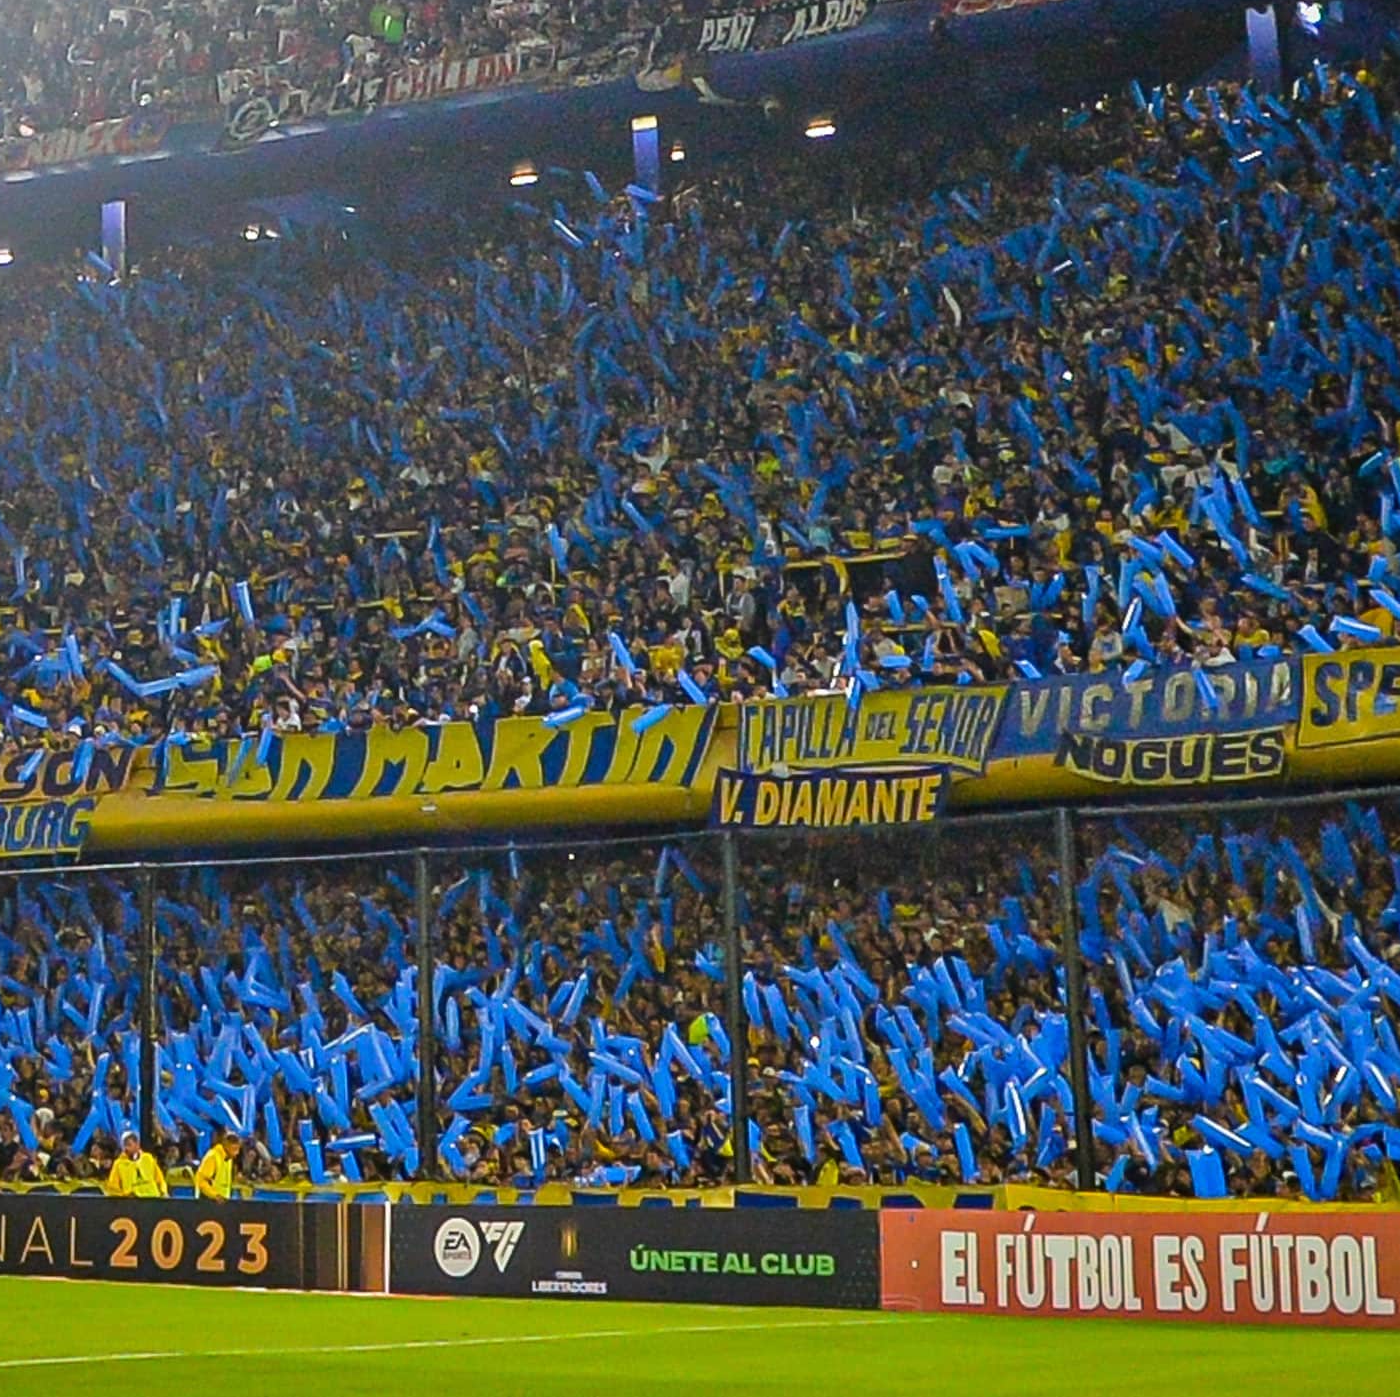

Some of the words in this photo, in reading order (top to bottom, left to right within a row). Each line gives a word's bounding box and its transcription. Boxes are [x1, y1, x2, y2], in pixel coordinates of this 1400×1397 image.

[864, 711, 897, 741] DEL
[1020, 661, 1294, 738] VICTORIA
[350, 705, 705, 800] MARTIN
[1054, 730, 1285, 781] NOGUES
[753, 773, 943, 826] DIAMANTE
[109, 1217, 269, 1275] 2023
[443, 1231, 472, 1250] EA
[630, 1244, 719, 1274] ÚNETE
[721, 1252, 757, 1275] AL
[760, 1253, 836, 1277] CLUB
[940, 1230, 985, 1305] EL
[996, 1213, 1142, 1312] FÚTBOL
[1152, 1235, 1208, 1312] ES
[1219, 1211, 1396, 1315] FÚTBOL
